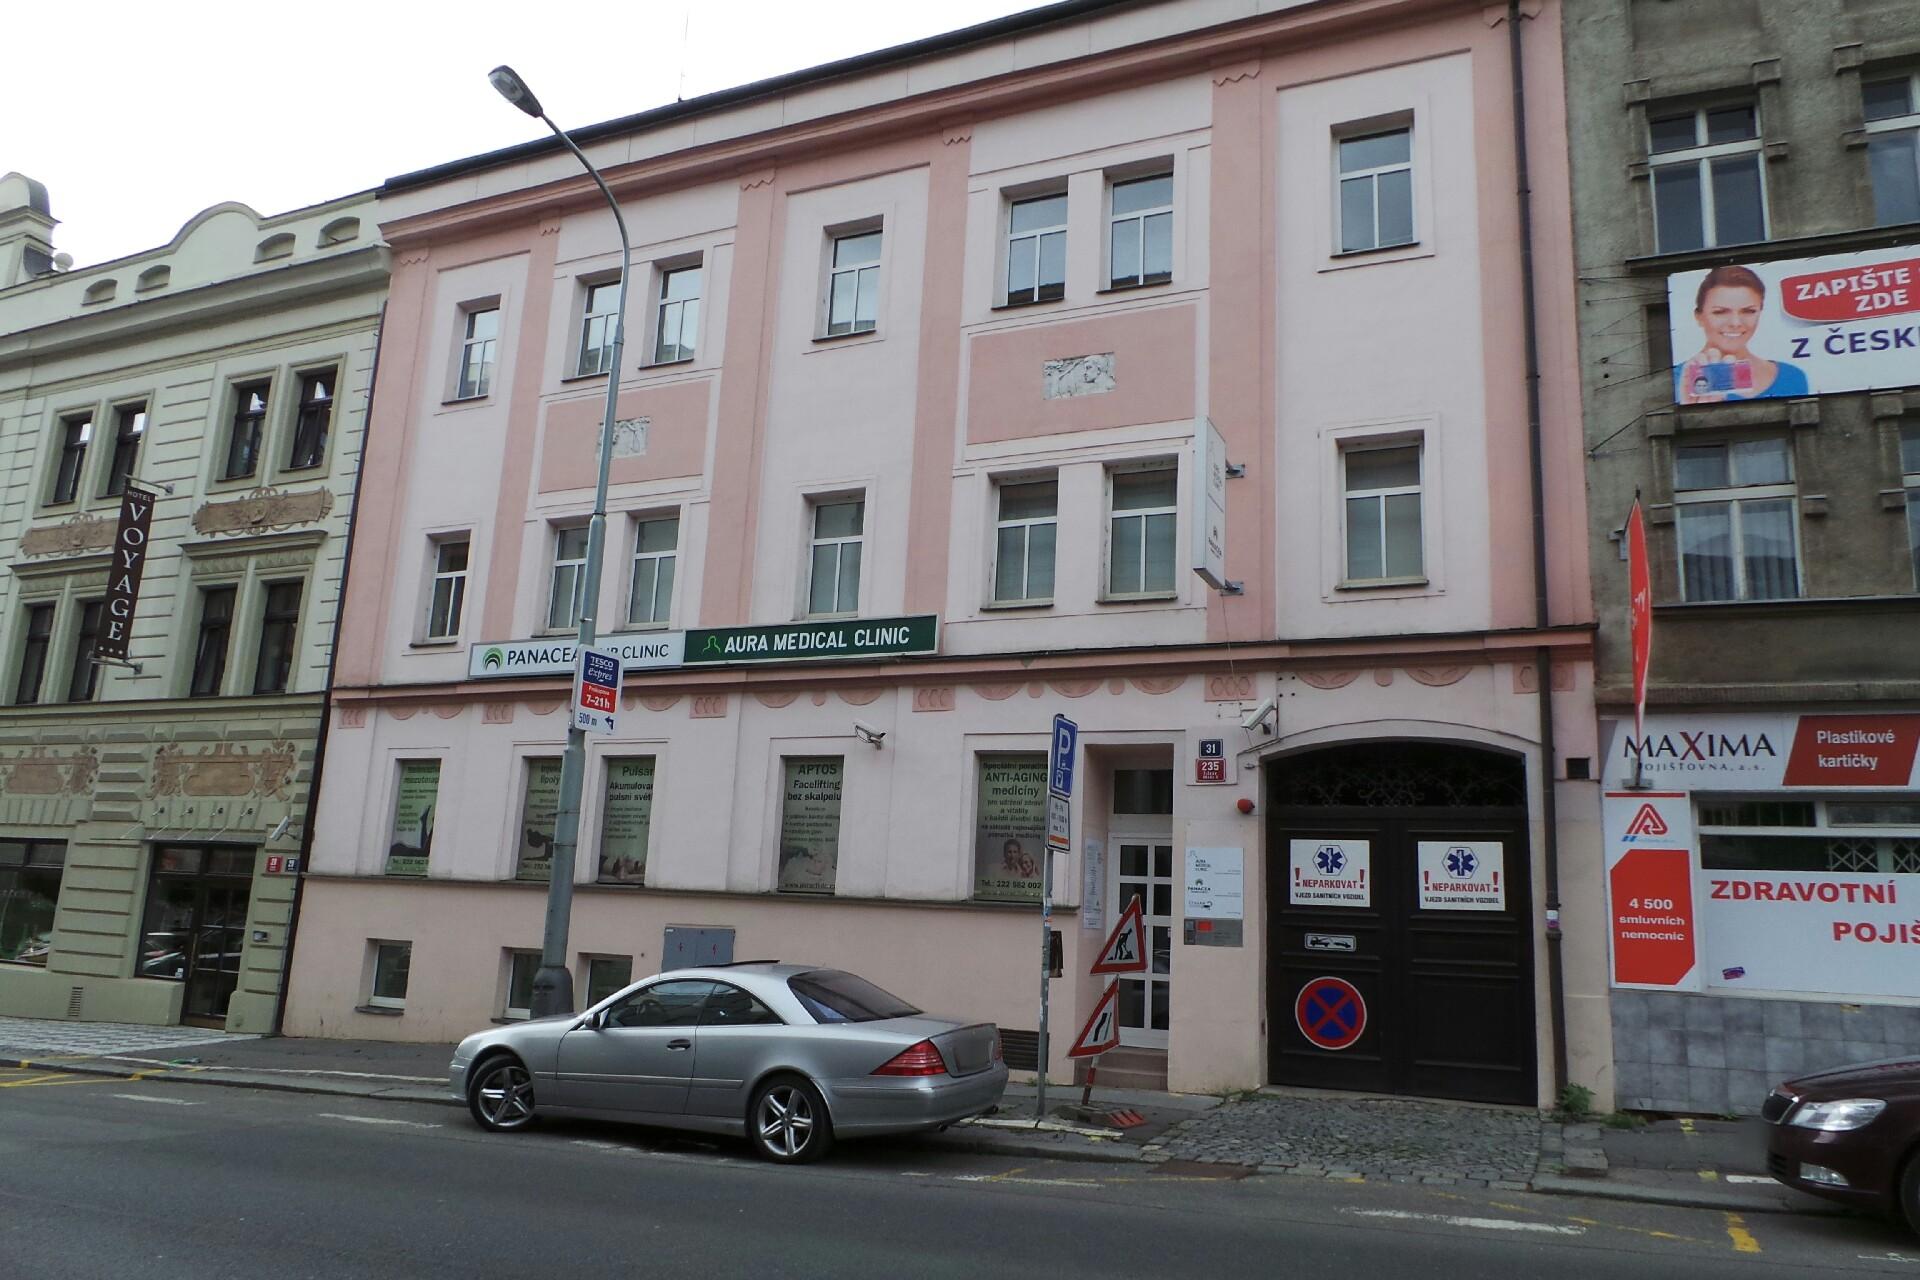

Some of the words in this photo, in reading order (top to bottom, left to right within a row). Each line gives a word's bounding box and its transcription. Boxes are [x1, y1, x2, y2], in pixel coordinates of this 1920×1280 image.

[1795, 267, 1911, 301] ZAPIŠTE
[1854, 288, 1909, 312] ZDE
[1791, 337, 1811, 358] Z
[1824, 326, 1920, 355] ČESK
[127, 489, 151, 502] HOTEL
[107, 502, 146, 641] VOYAGE
[724, 634, 769, 653] AURA
[773, 630, 848, 651] MEDICAL
[854, 626, 910, 647] CLINIC
[622, 644, 669, 660] CLINIC
[590, 656, 614, 669] TESCO
[588, 667, 613, 681] expres
[578, 712, 591, 725] 500
[591, 717, 598, 726] m
[1816, 729, 1896, 744] Plastikové
[1057, 727, 1071, 768] P
[1206, 743, 1216, 754] 31
[1623, 731, 1776, 761] MAXIMA
[1201, 761, 1220, 771] 235
[1818, 753, 1878, 771] kartičky
[798, 764, 837, 776] APTOS
[984, 772, 1048, 783] ANTI-AGING
[793, 779, 841, 790] Facelifting
[787, 791, 802, 801] bez
[804, 791, 841, 802] skalpelu
[992, 785, 1040, 798] medicíny
[1302, 879, 1357, 889] NEPARKOVAT
[1432, 883, 1491, 893] NEPARKOVAT
[1711, 880, 1896, 904] ZDRAVOTNÍ
[1629, 898, 1639, 909] 4
[1643, 898, 1673, 910] 500
[1619, 915, 1686, 926] smluvních
[1622, 930, 1686, 941] nemocnic
[1833, 920, 1920, 944] POJIŠ
